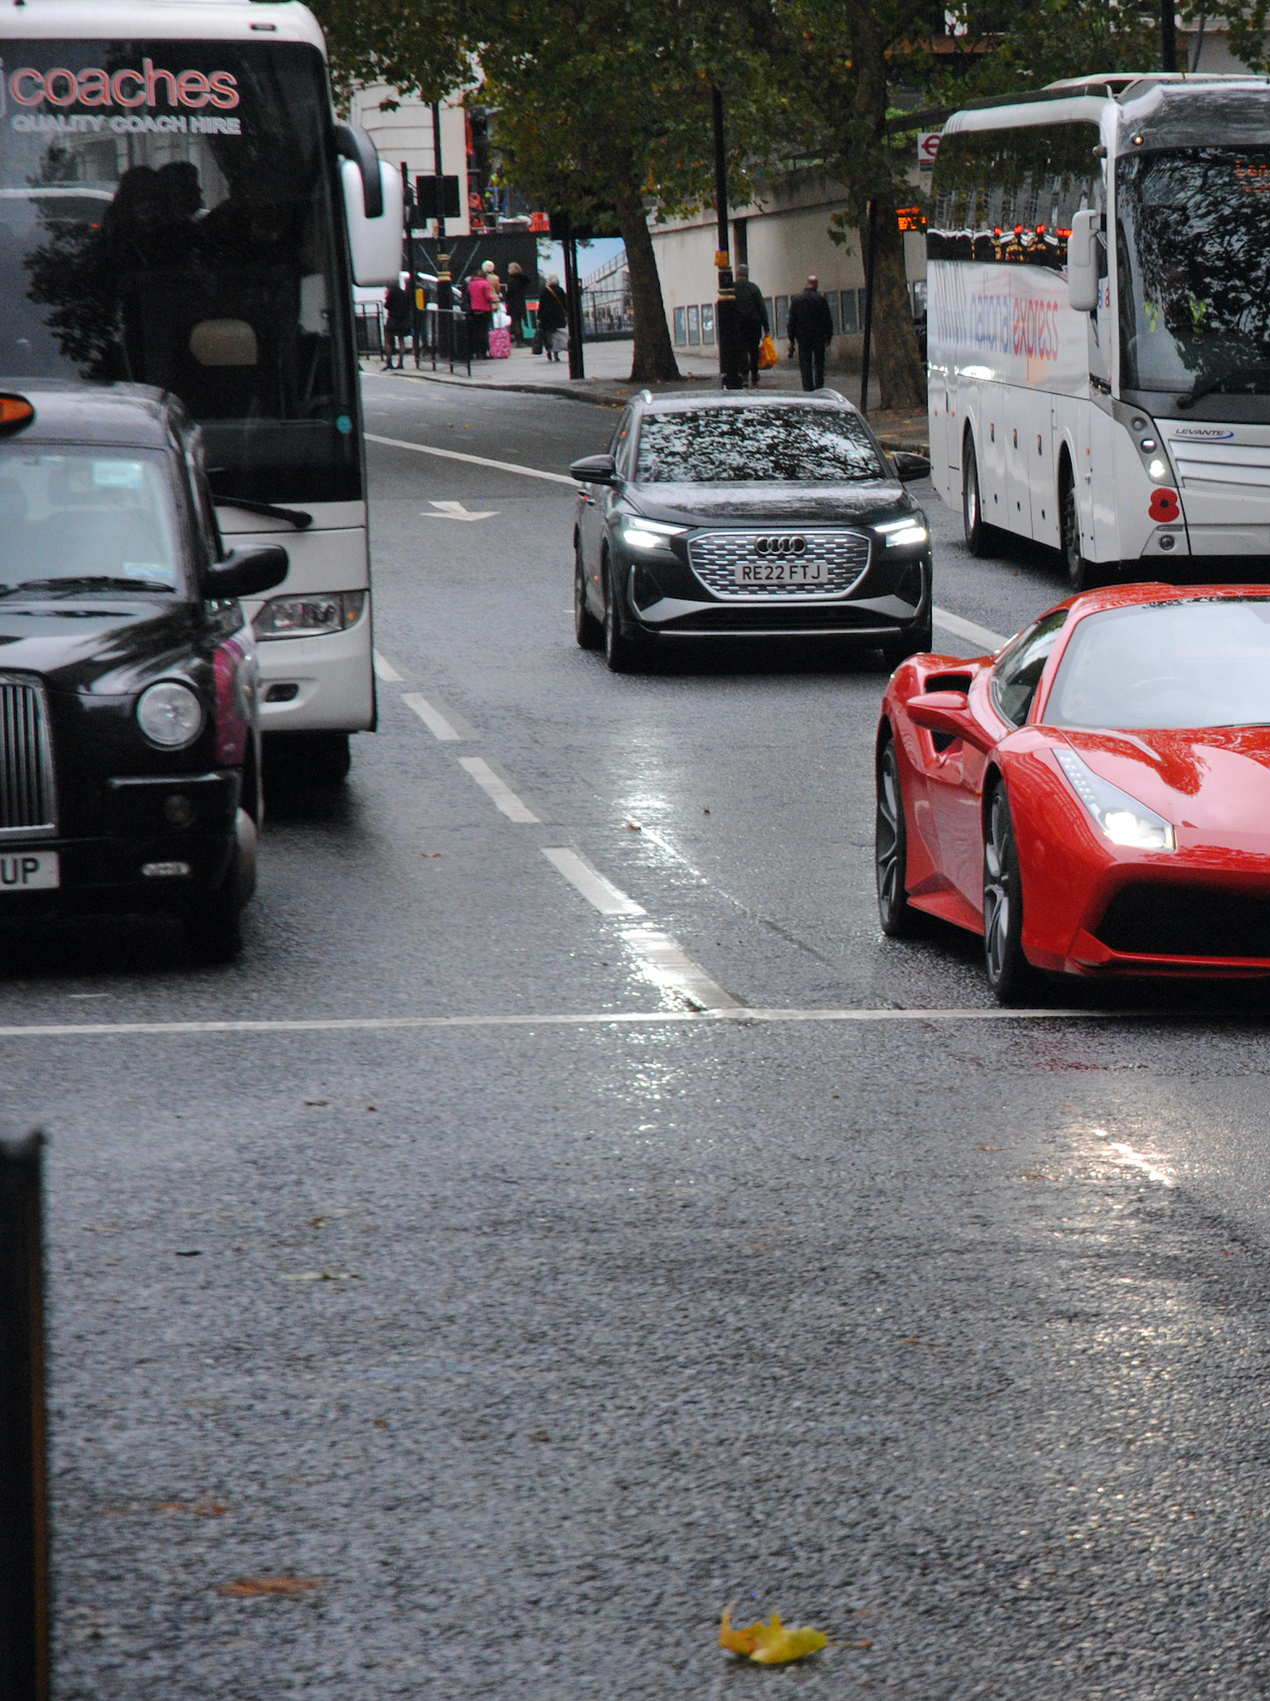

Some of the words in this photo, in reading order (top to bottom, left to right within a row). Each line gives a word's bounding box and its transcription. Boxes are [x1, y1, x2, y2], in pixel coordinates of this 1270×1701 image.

[9, 57, 241, 109] coaches
[11, 114, 106, 133] QUALITY
[108, 114, 188, 134] COACH
[189, 116, 242, 135] HIRE
[1012, 297, 1059, 382] express
[1175, 428, 1225, 436] LEVANTE
[742, 565, 784, 580] RE22
[789, 565, 820, 580] FTJ
[1, 858, 41, 885] UP
